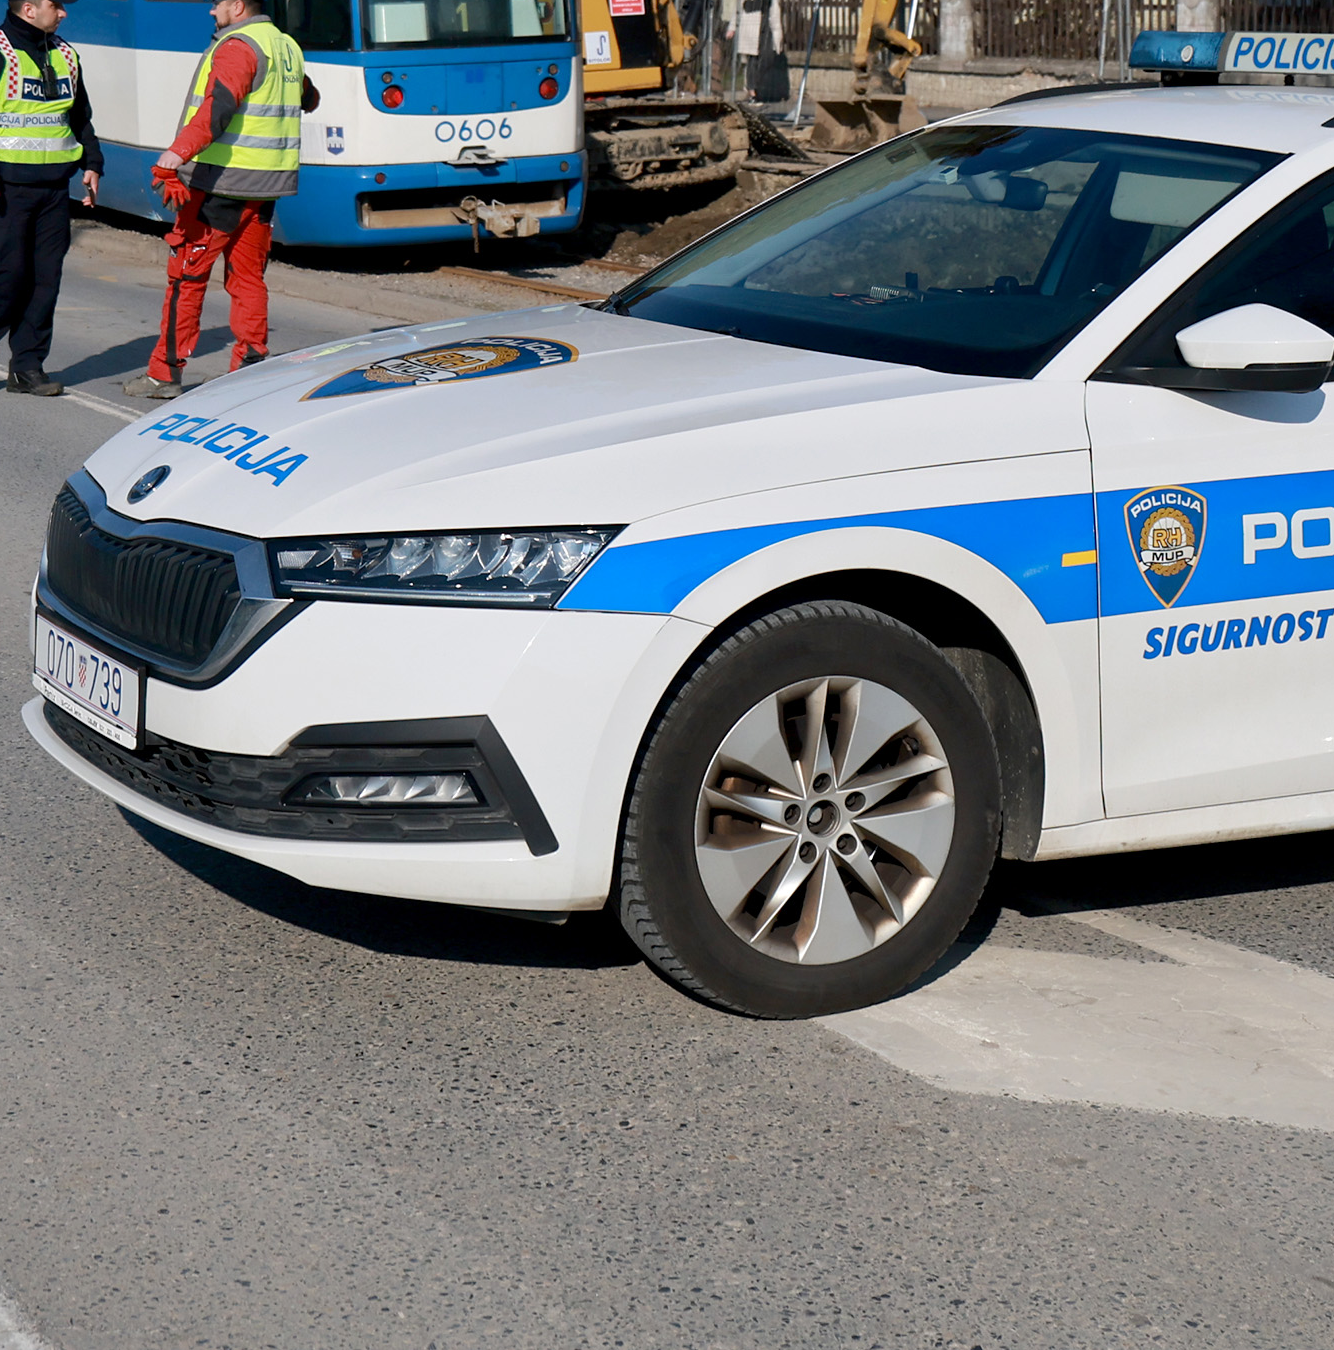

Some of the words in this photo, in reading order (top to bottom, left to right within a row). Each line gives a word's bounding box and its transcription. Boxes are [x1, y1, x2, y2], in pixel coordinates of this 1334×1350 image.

[456, 2, 469, 32] 1
[24, 82, 69, 97] POLA
[26, 115, 61, 125] POLICIJA
[435, 118, 512, 142] 0606
[418, 352, 485, 371] RH
[461, 338, 564, 365] POLICIJA
[390, 362, 438, 377] MUP
[138, 413, 309, 487] POLICIJA
[1130, 493, 1202, 518] POLICIJA
[1152, 527, 1182, 548] RH
[1152, 550, 1184, 562] MUP
[1143, 605, 1334, 660] SIGURNOST
[48, 629, 75, 689] 070
[88, 654, 122, 717] 739
